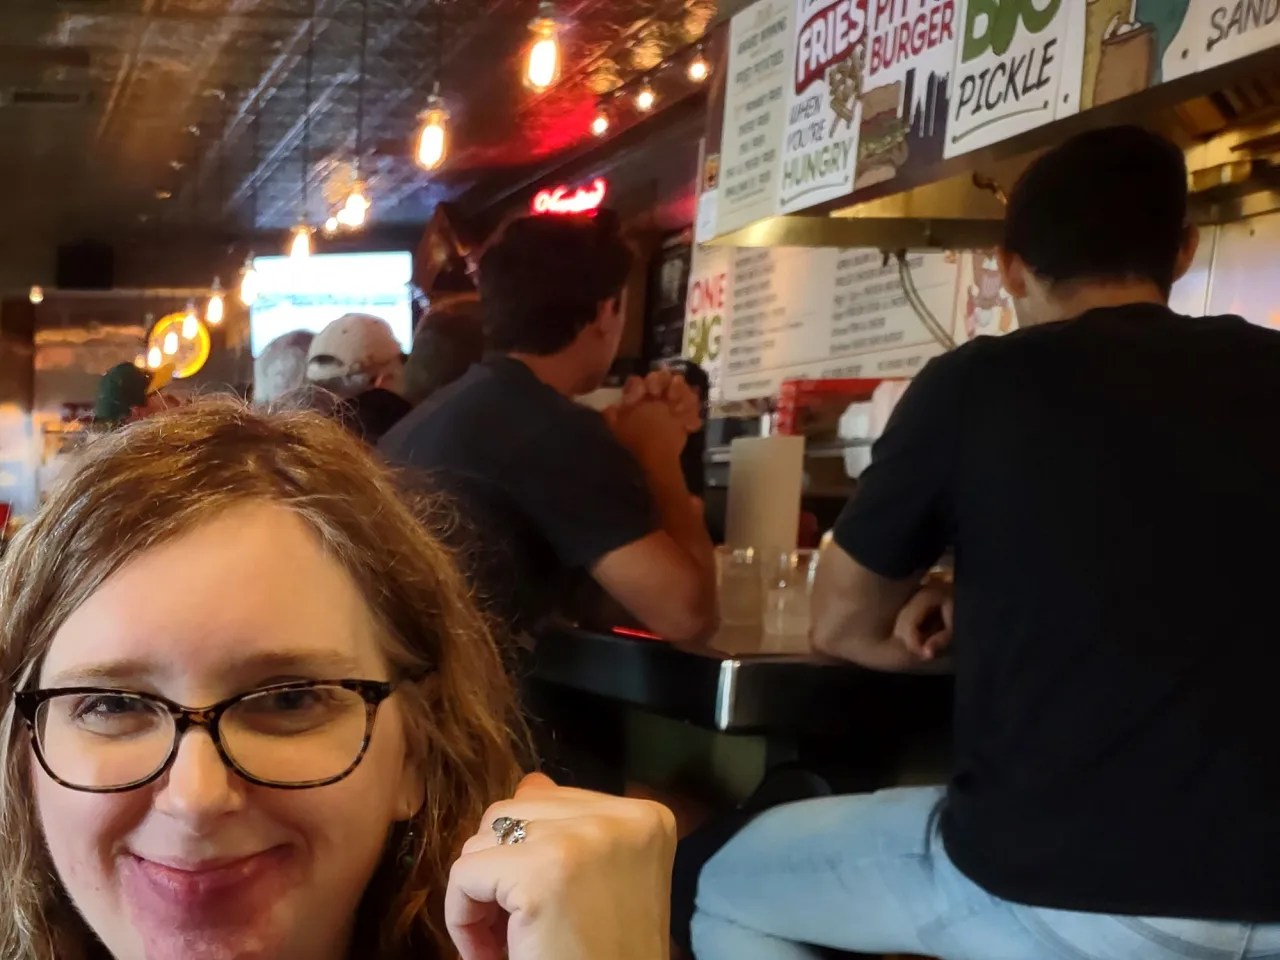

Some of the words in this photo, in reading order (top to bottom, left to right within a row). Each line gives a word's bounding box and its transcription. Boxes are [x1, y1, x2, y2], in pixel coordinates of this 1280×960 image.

[796, 0, 865, 84] FRIES
[869, 0, 955, 76] BURGER
[789, 95, 822, 126] WHEN
[954, 38, 1057, 121] PICKLE
[781, 136, 854, 191] HUNGRY
